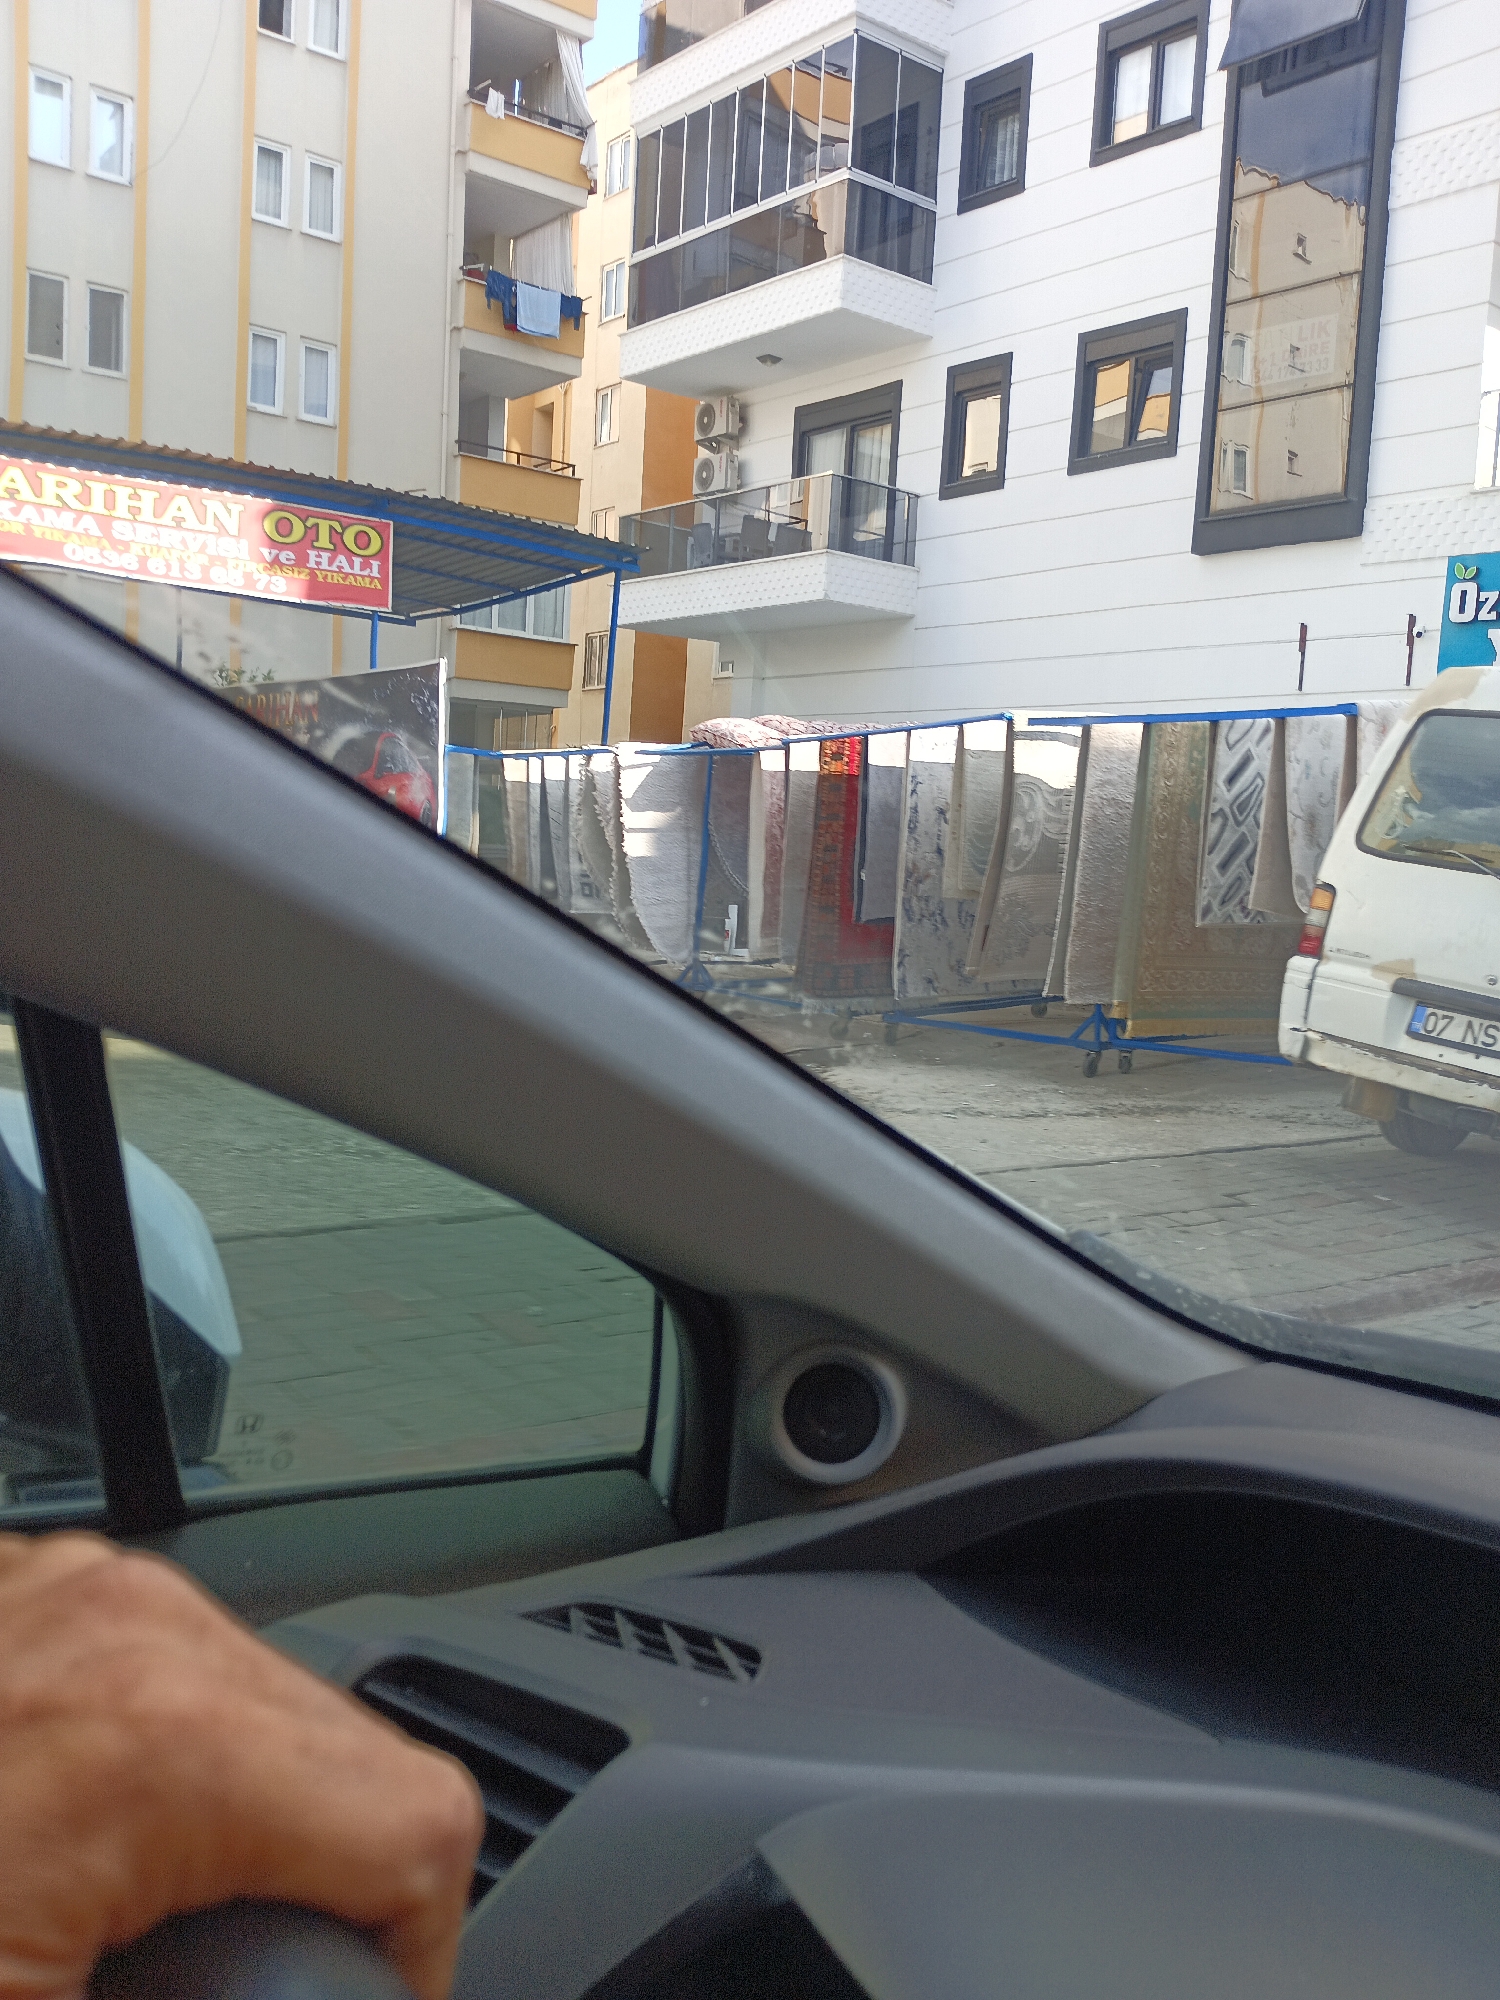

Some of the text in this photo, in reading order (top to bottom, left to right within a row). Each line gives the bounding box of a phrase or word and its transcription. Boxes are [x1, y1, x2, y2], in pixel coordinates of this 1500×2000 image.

[262, 509, 384, 557] OTO
[259, 547, 296, 565] ve
[306, 549, 382, 578] HALI
[252, 573, 288, 594] 73
[315, 569, 382, 590] YIKAMA
[1423, 1011, 1455, 1037] 07
